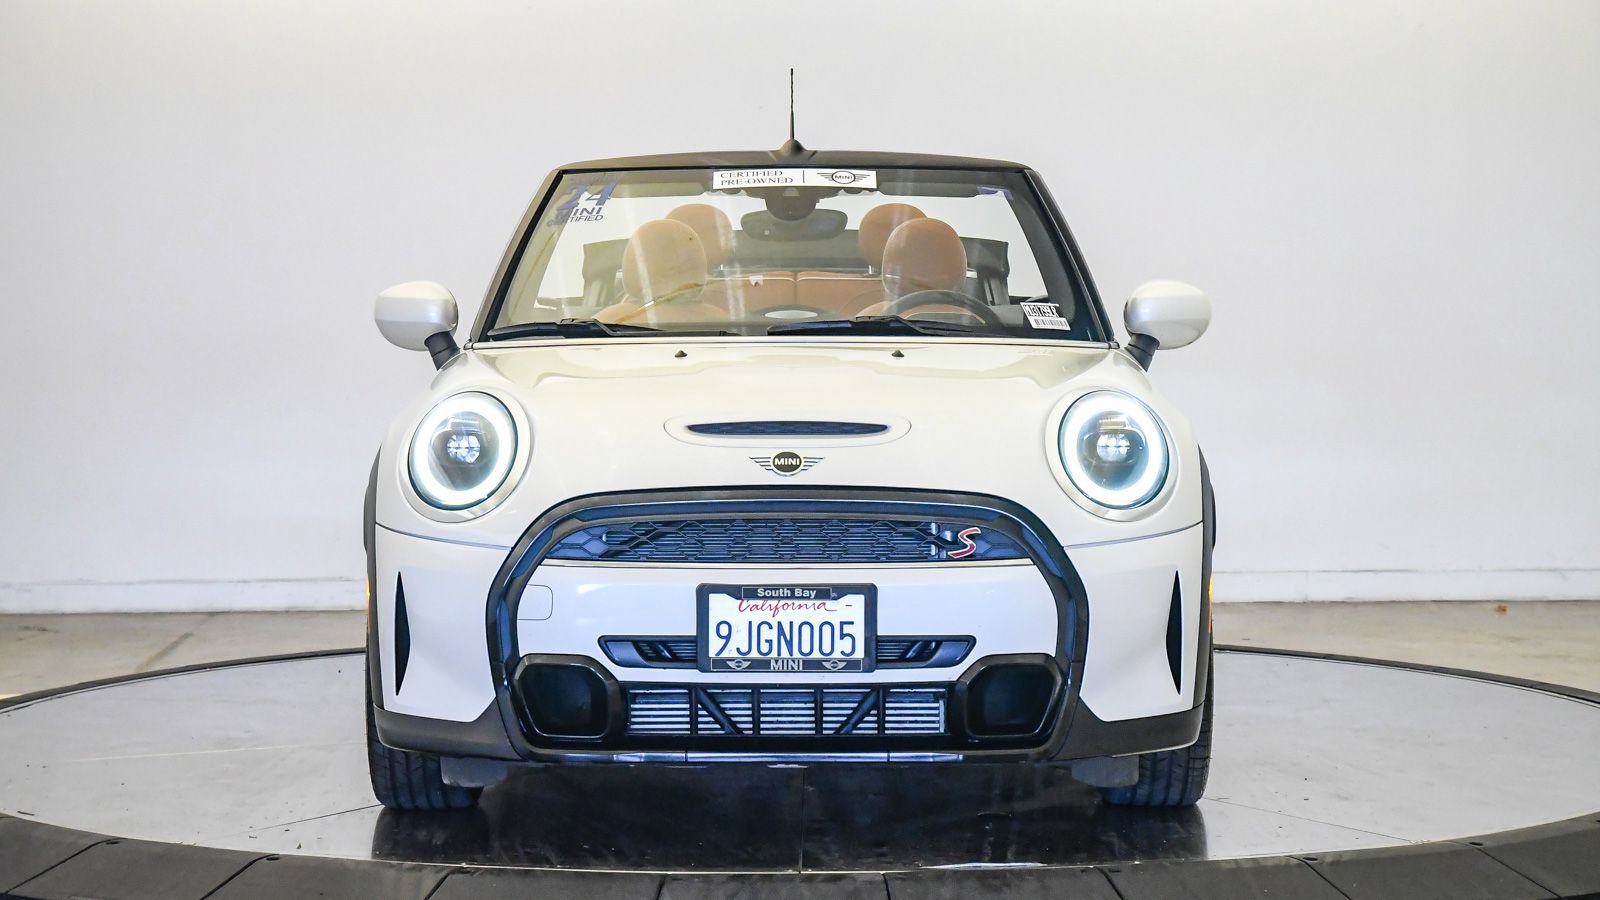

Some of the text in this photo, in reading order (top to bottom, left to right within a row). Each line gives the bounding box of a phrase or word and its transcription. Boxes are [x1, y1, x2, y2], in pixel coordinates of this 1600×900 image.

[720, 170, 783, 179] CERTIFIED
[720, 177, 793, 186] PRE-OWNED
[774, 457, 800, 466] MINI
[947, 527, 982, 559] S
[757, 588, 817, 599] South Bay
[738, 600, 838, 618] California
[715, 620, 856, 657] 9JGN005
[770, 659, 803, 671] MINI
